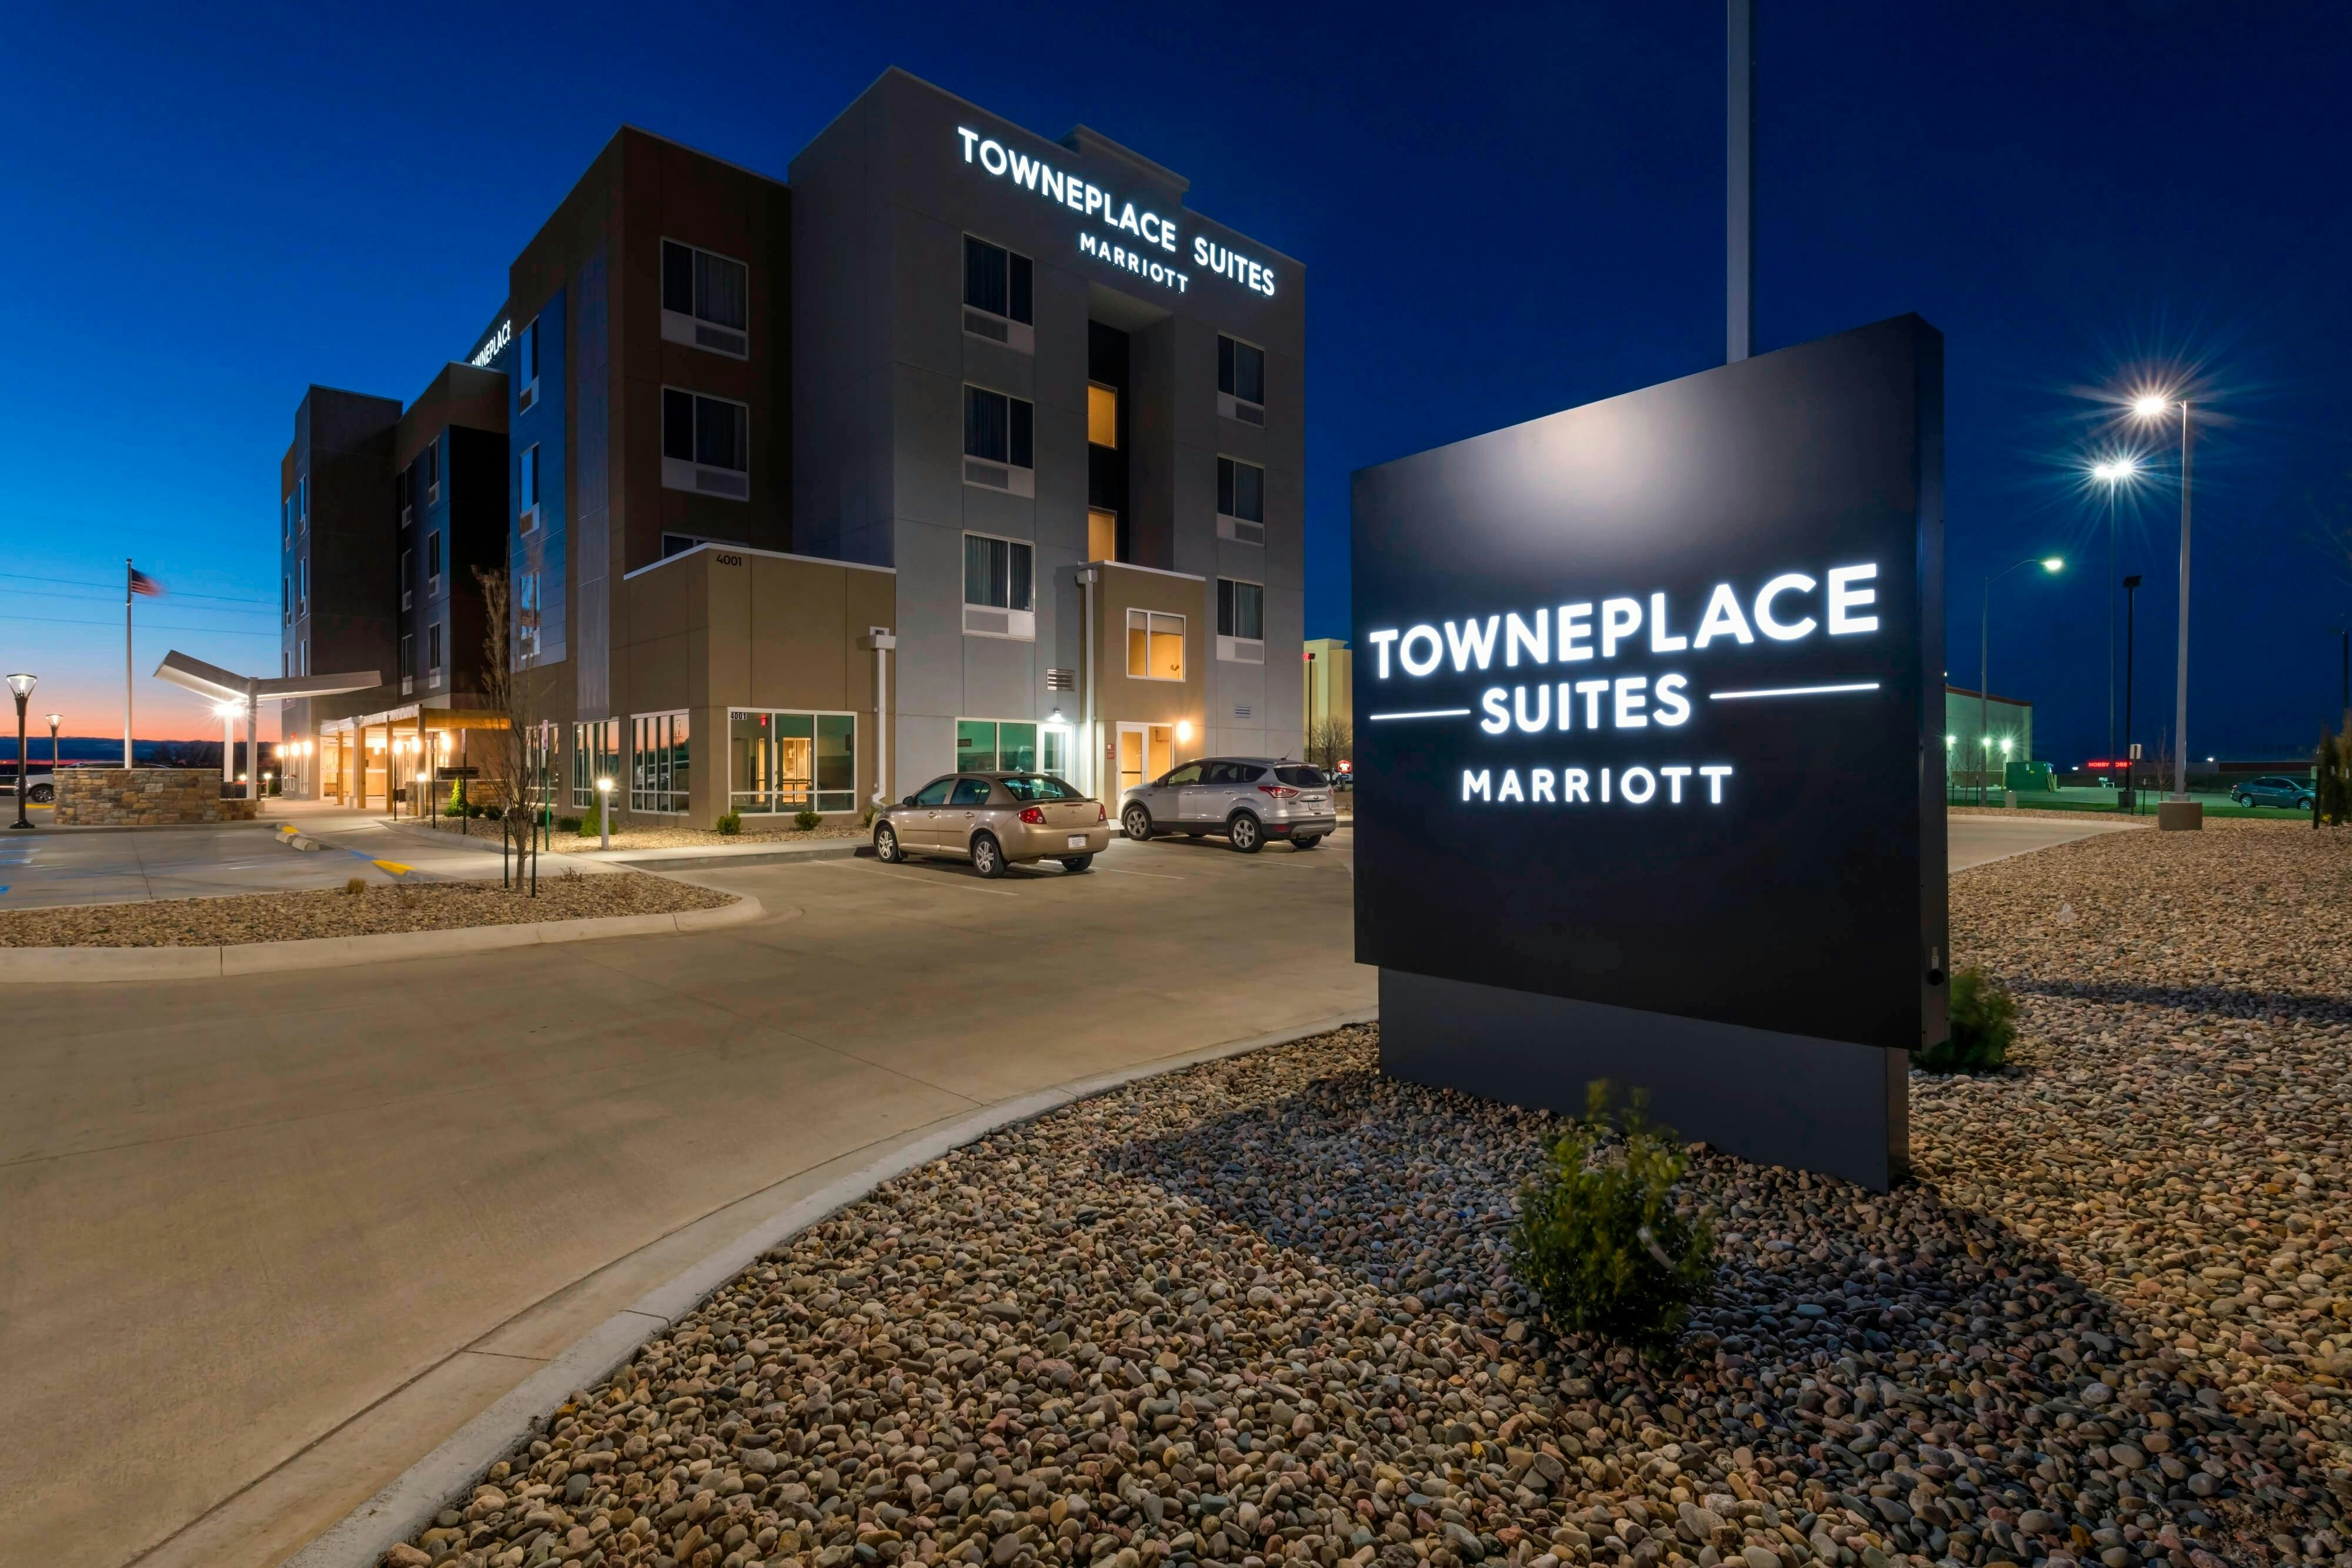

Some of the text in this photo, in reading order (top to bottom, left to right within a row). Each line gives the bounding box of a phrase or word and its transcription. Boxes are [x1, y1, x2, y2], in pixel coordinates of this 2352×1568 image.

[958, 126, 1275, 296] TOWNEPLACE SUITES
[1080, 232, 1188, 293] MARRIOTT
[472, 319, 510, 367] WNEPLACE
[716, 554, 742, 566] 4001
[1369, 562, 1879, 680] TOWNEPLACE
[730, 711, 746, 720] 4001
[1480, 673, 1691, 735] SUITES
[1462, 765, 1733, 804] MARRIOTT
